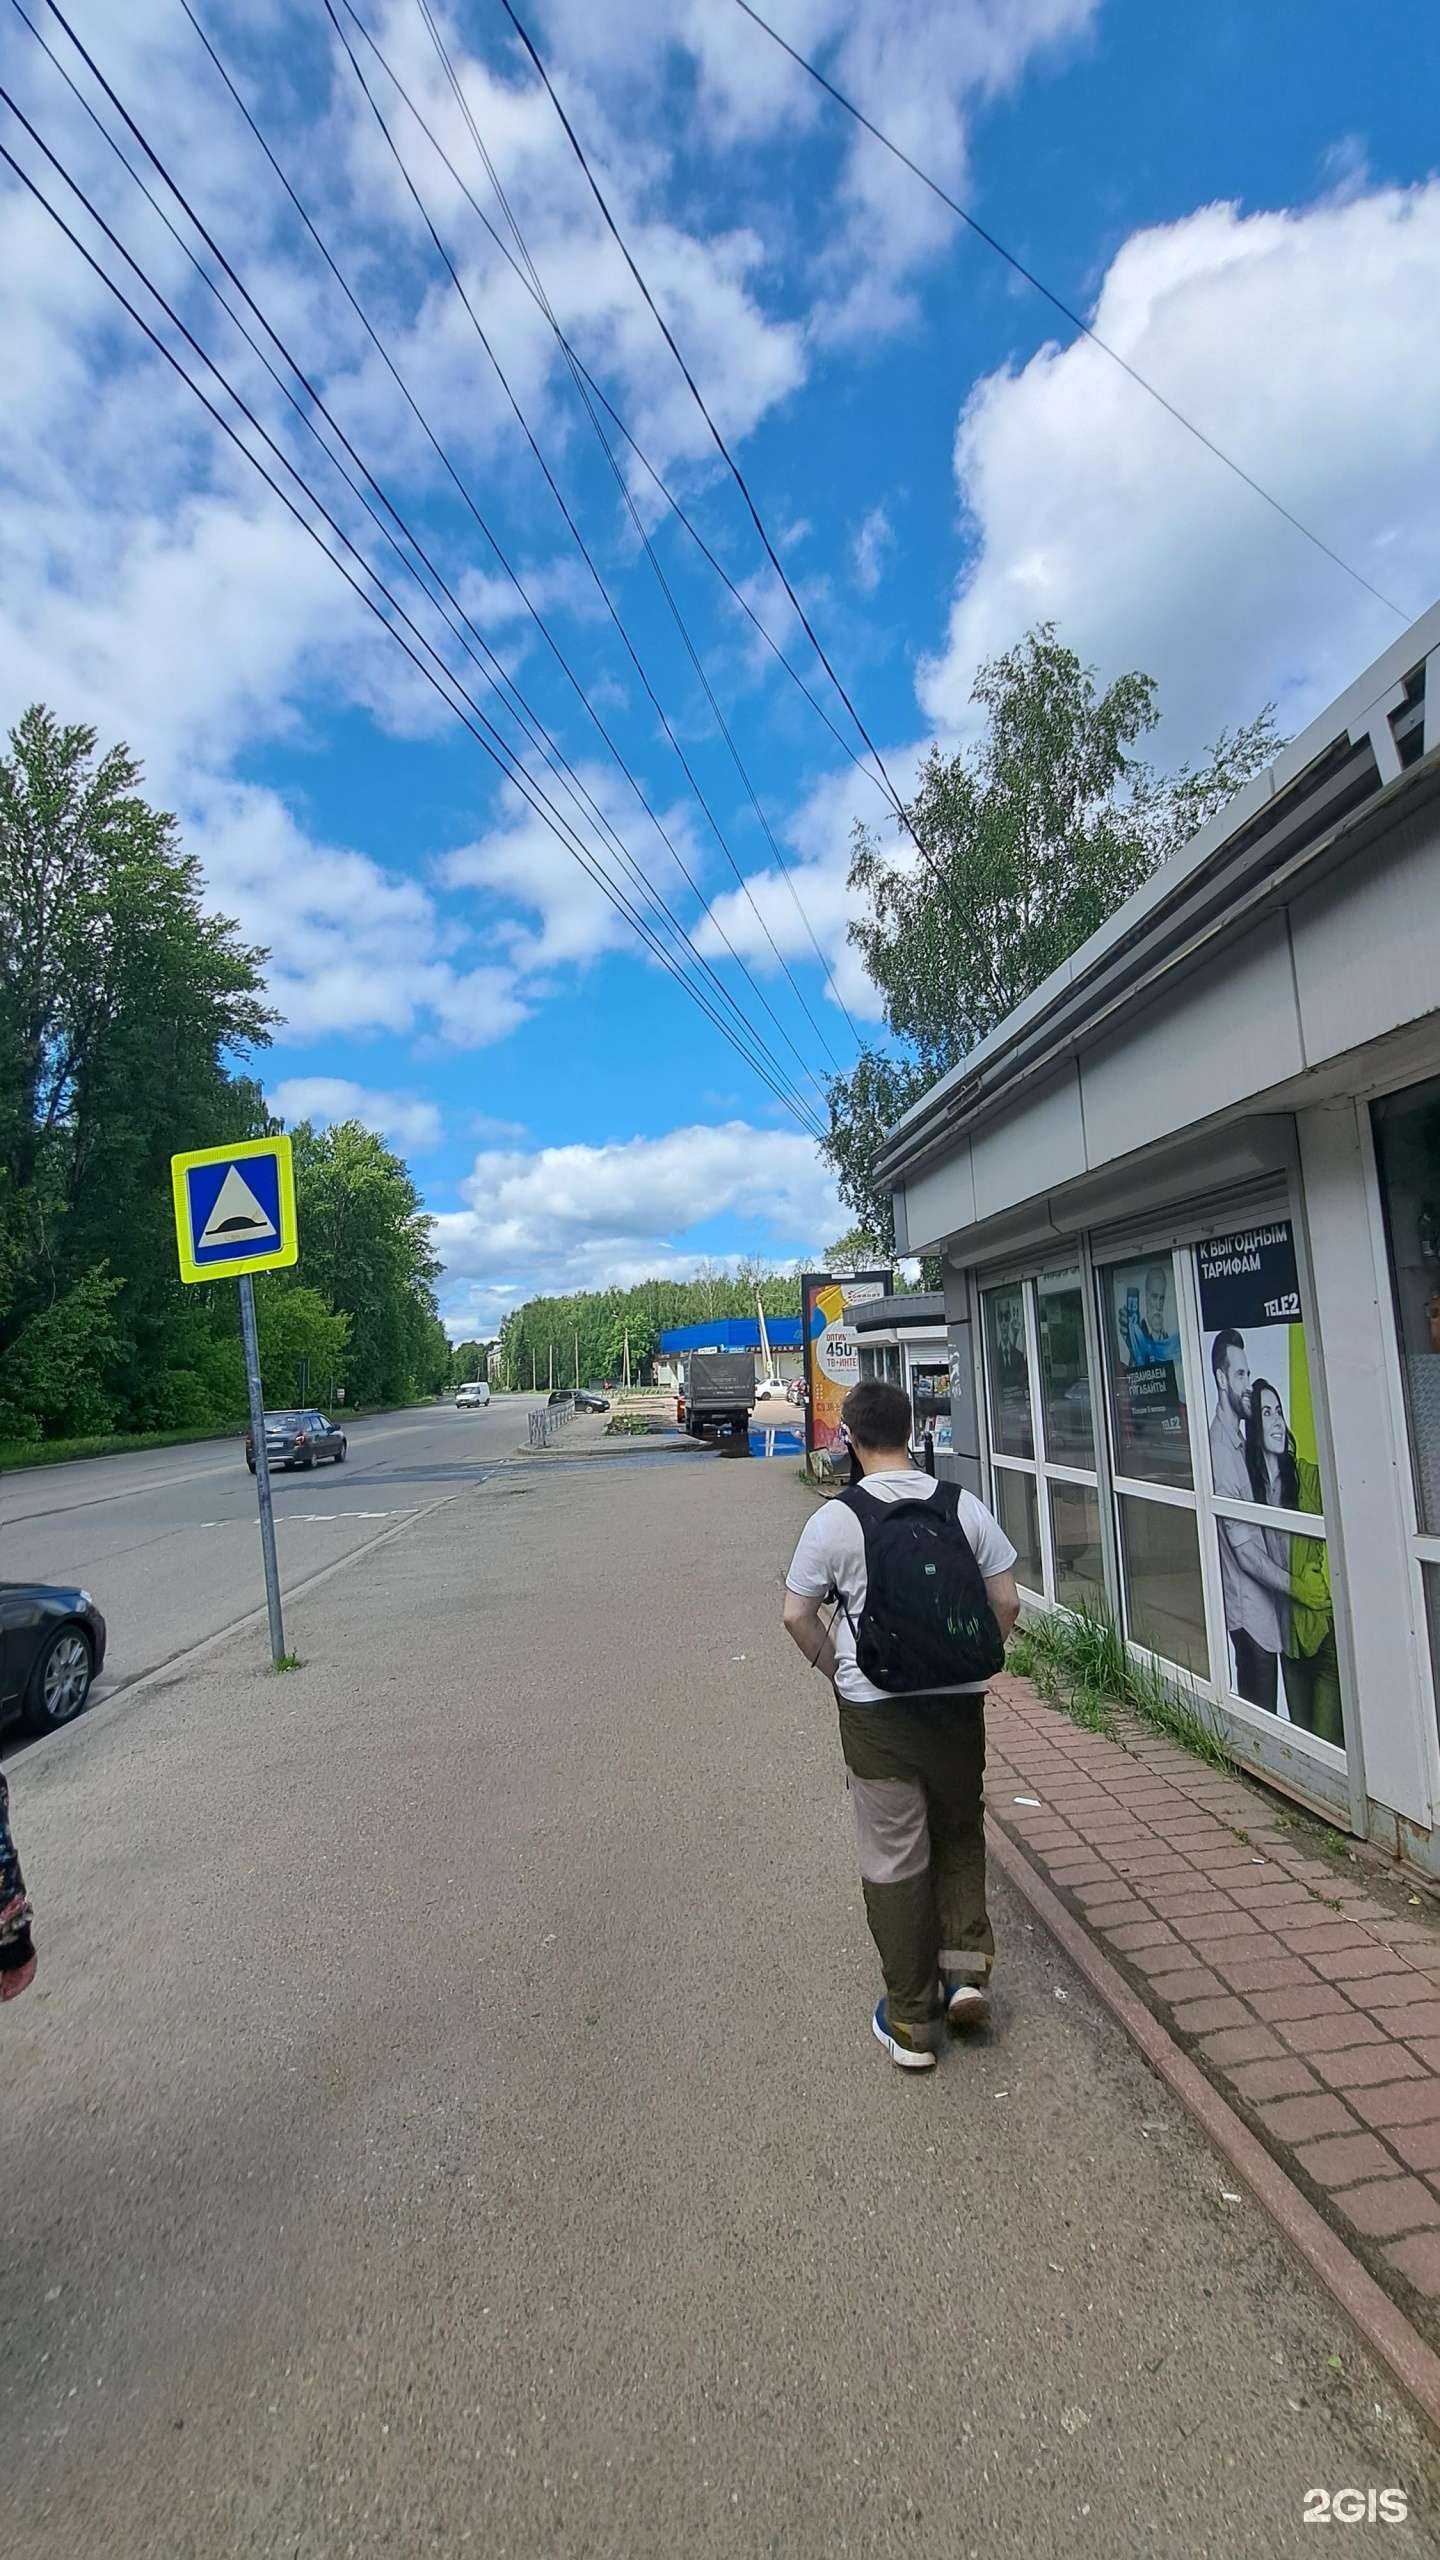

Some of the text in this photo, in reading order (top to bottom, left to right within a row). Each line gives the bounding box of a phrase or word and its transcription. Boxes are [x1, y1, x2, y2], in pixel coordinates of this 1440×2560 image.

[1200, 1224, 1288, 1259] К ВЫГОДНЫМ
[1201, 1253, 1261, 1280] ТАРИФАМ
[1264, 1292, 1301, 1317] TELE2
[826, 1342, 852, 1357] 450
